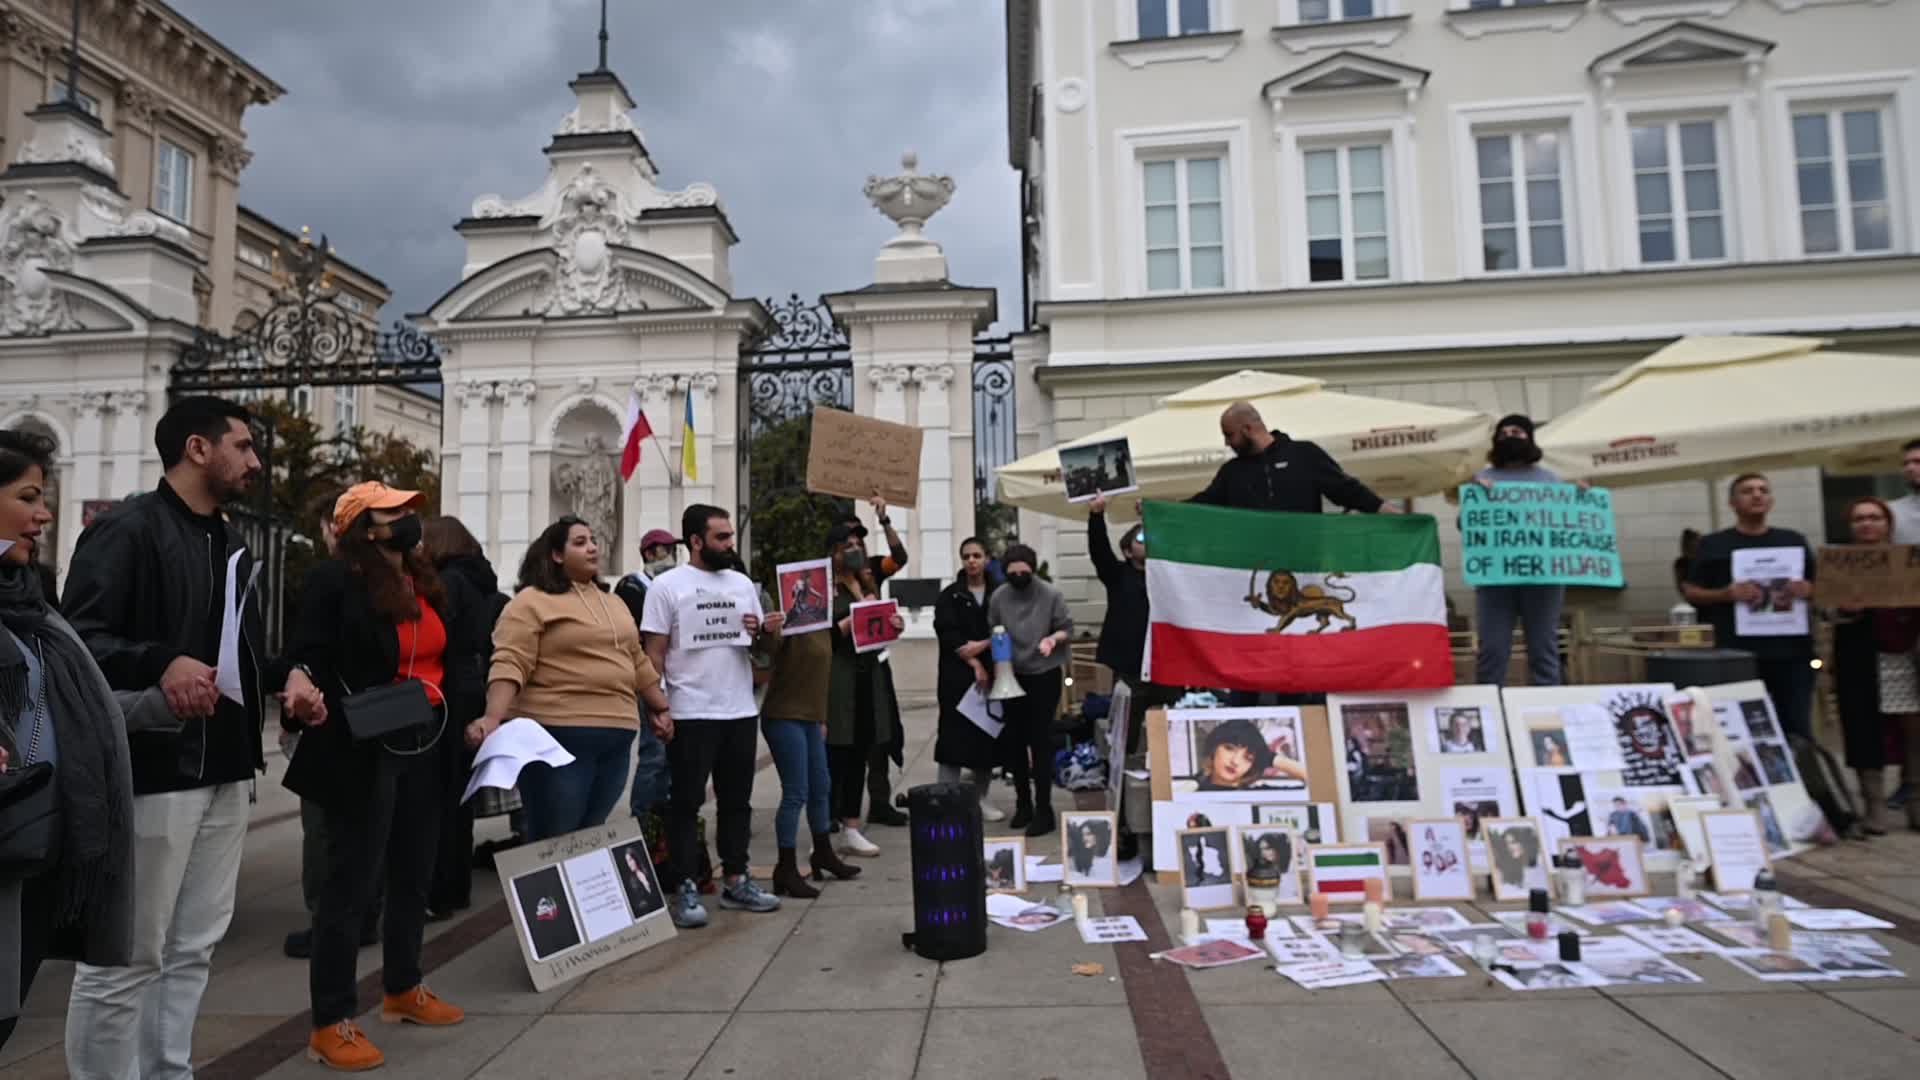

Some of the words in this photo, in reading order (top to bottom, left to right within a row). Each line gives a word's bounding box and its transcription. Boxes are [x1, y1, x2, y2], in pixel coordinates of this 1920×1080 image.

[1463, 488, 1479, 503] A
[1488, 486, 1571, 505] WOMAN
[1575, 489, 1608, 510] HAS
[1467, 509, 1519, 527] BEEN
[1525, 509, 1606, 529] KILLED
[1466, 530, 1487, 547] IN
[1494, 530, 1544, 548] IRAN
[1551, 531, 1617, 552] BECAUSE
[1466, 555, 1493, 576] OF
[1504, 554, 1544, 577] HER
[1551, 555, 1612, 577] HIJAB
[696, 601, 736, 611] WOMAN
[705, 616, 728, 627] LIFE
[693, 631, 741, 643] FREEDOM
